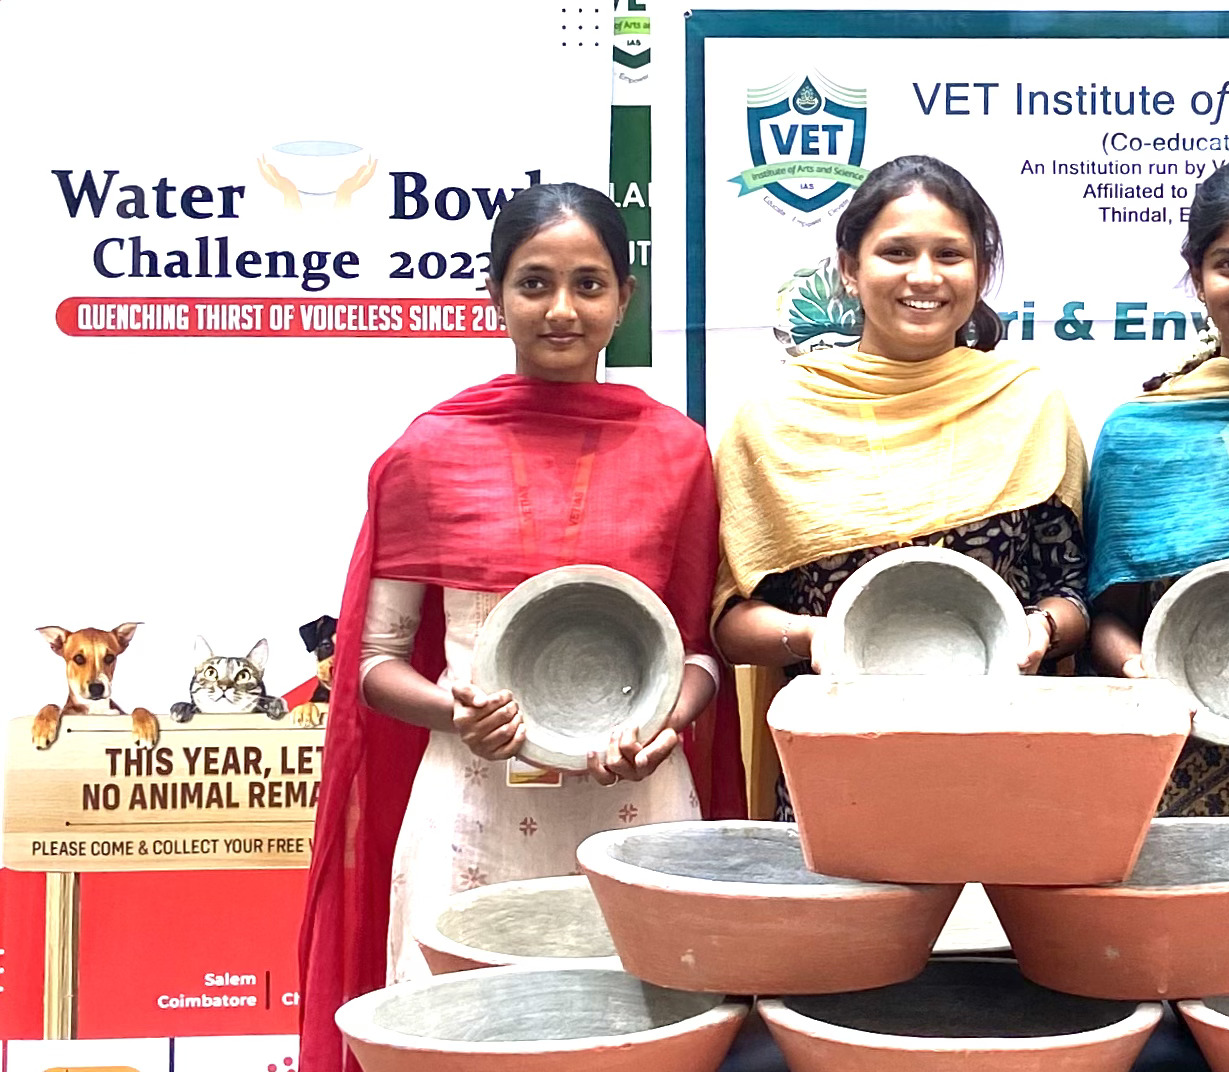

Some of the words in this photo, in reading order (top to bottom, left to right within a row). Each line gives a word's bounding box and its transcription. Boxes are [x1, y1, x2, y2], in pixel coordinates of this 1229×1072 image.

[624, 21, 641, 29] Arts
[912, 82, 1000, 116] VET
[1016, 82, 1175, 116] Institute
[769, 123, 844, 156] VET
[752, 167, 787, 181] Institute
[787, 165, 796, 175] of
[796, 165, 815, 173] Arts
[834, 167, 865, 181] Science
[1020, 159, 1045, 175] An
[1052, 159, 1142, 175] Institution
[1149, 163, 1178, 175] run
[1185, 160, 1206, 178] by
[50, 169, 246, 220] Water
[1082, 183, 1164, 199] Affiliated
[1171, 184, 1188, 199] to
[1099, 206, 1173, 226] Thindal,
[93, 235, 360, 293] Challenge
[77, 303, 189, 330] QUENCHING
[194, 304, 264, 331] THIRST
[269, 304, 295, 331] OF
[300, 304, 403, 331] VOICELESS
[409, 304, 466, 331] SINCE
[472, 305, 506, 331] 20
[1054, 301, 1095, 341] &
[106, 747, 174, 776] THIS
[182, 746, 272, 779] YEAR,
[82, 783, 121, 811] NO
[128, 781, 240, 811] ANIMAL
[249, 781, 320, 808] REMA
[32, 840, 87, 857] PLEASE
[90, 840, 134, 857] COME
[138, 840, 149, 856] &
[152, 838, 220, 855] COLLECT
[223, 838, 264, 854] YOUR
[267, 837, 304, 854] FREE
[204, 972, 257, 987] Salem
[157, 993, 257, 1009] Coimbatore
